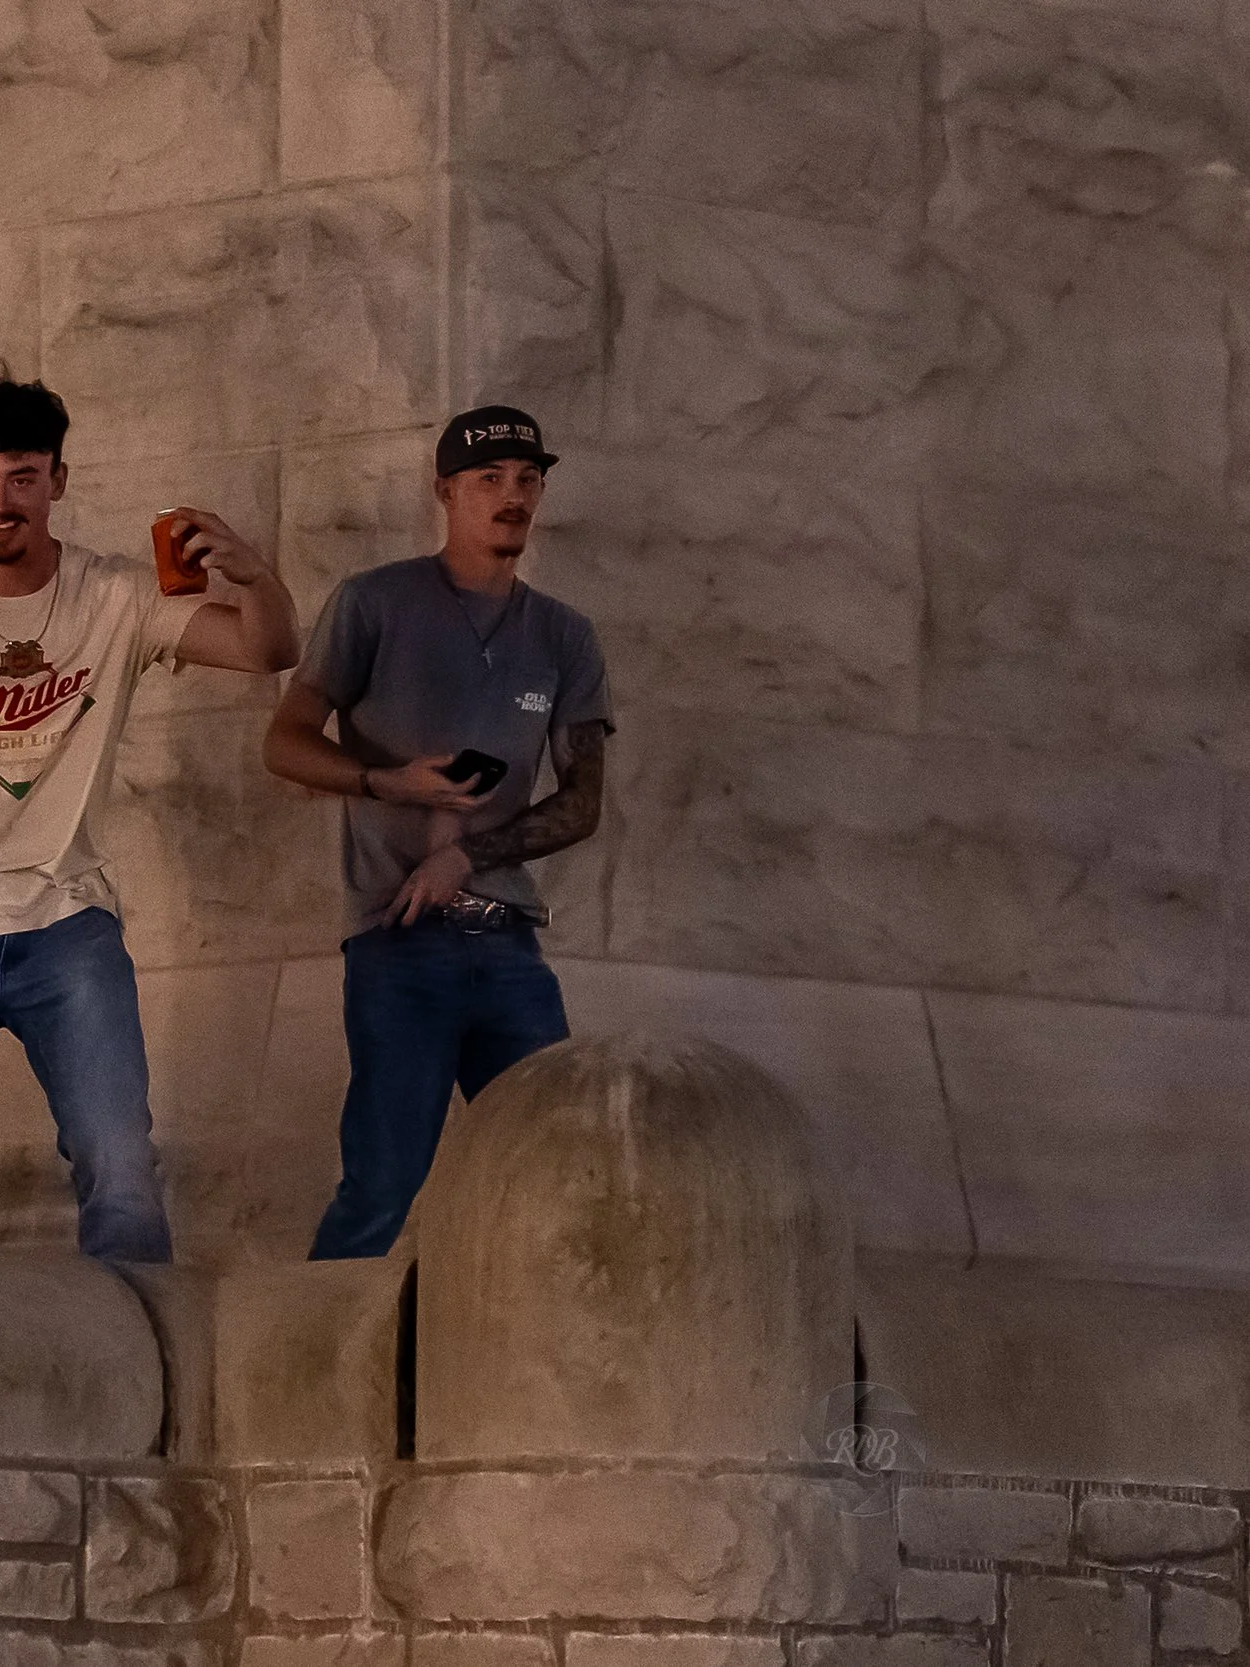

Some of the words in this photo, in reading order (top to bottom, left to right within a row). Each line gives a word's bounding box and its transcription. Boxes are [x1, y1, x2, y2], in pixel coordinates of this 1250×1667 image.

[488, 424, 510, 434] TOP
[525, 692, 546, 703] OLD
[31, 730, 64, 747] LIF
